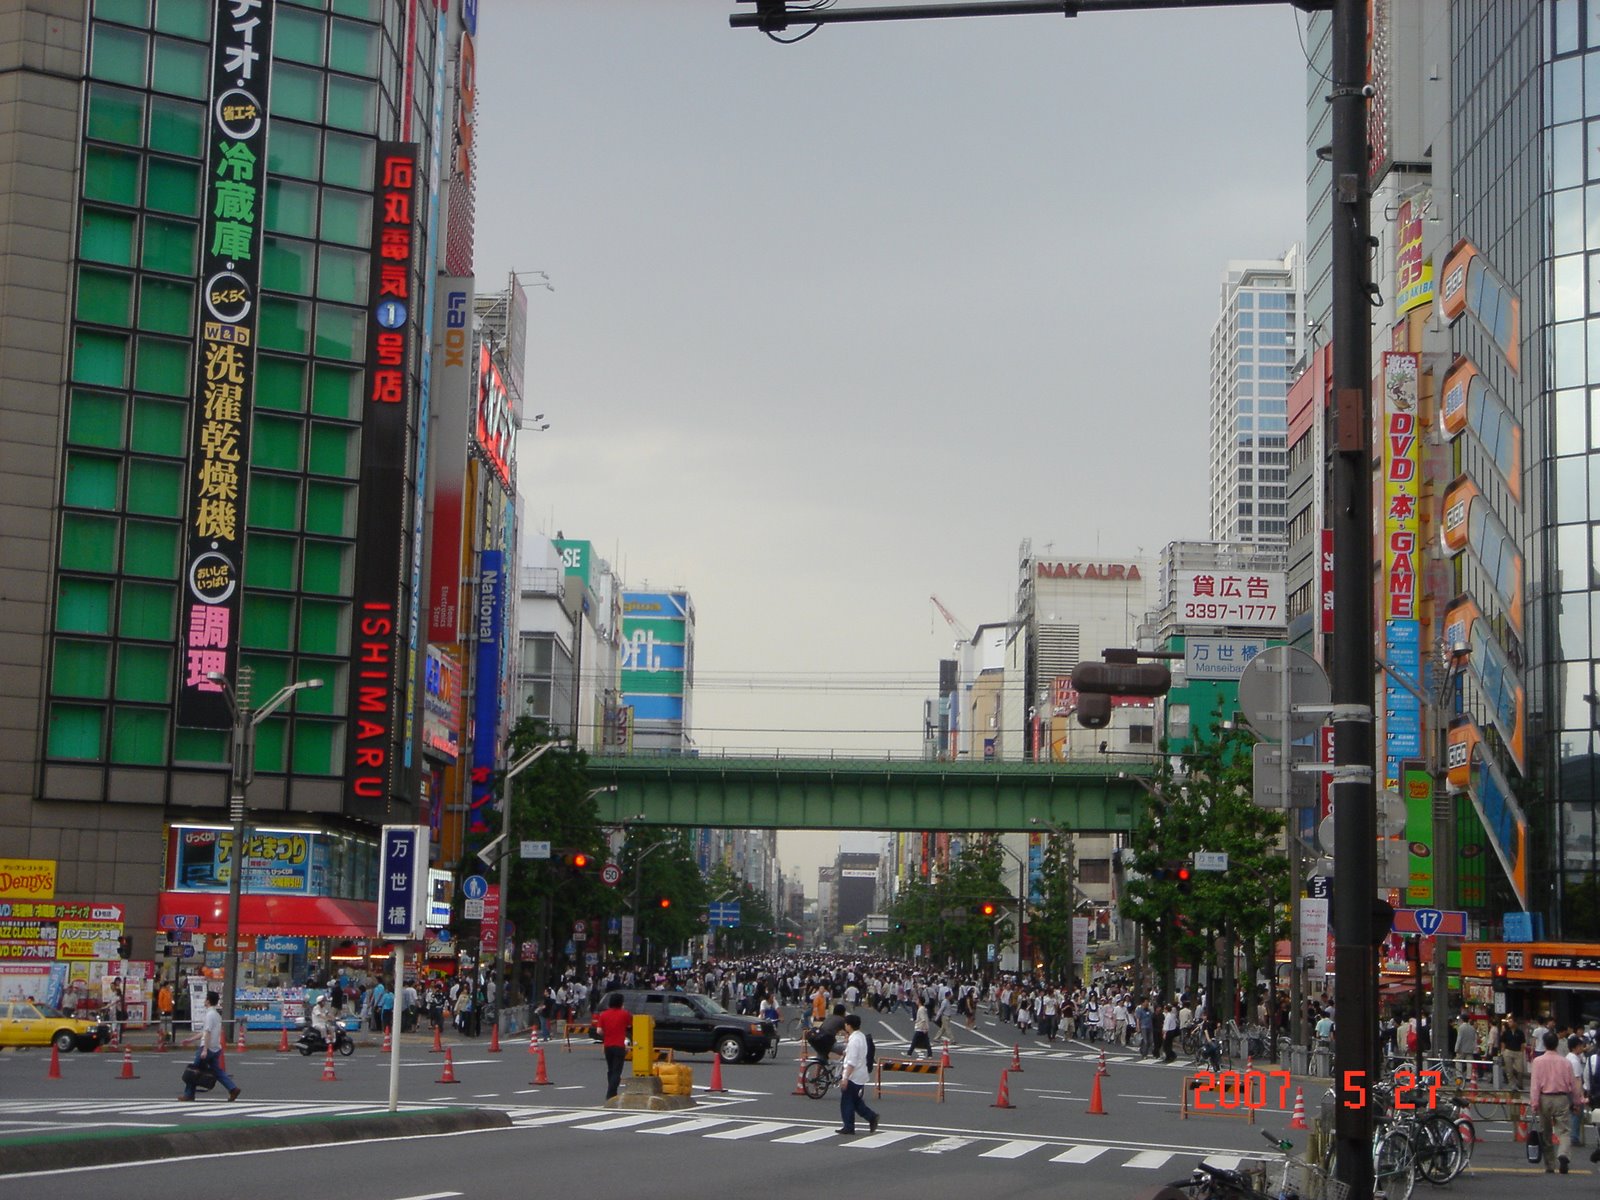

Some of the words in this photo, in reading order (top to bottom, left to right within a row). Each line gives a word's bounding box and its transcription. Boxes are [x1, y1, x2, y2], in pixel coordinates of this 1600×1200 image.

[223, 104, 256, 122] 省エネ
[211, 141, 257, 261] 冷蔵庫
[211, 288, 247, 305] らくらく
[195, 342, 246, 541] 洗濯乾燥機
[197, 565, 229, 579] おいしさ
[1037, 562, 1142, 581] NAKAURA
[1192, 575, 1269, 599] 貸広告
[480, 570, 498, 644] National
[1185, 603, 1277, 621] 3397-1777
[186, 604, 230, 692] 調理
[1192, 644, 1259, 661] 万世橋
[354, 603, 392, 797] ISHIMARU
[0, 872, 52, 893] Denny's
[388, 839, 409, 925] 万世橋
[605, 870, 618, 880] 50
[176, 916, 184, 925] 17
[1420, 912, 1438, 928] 17
